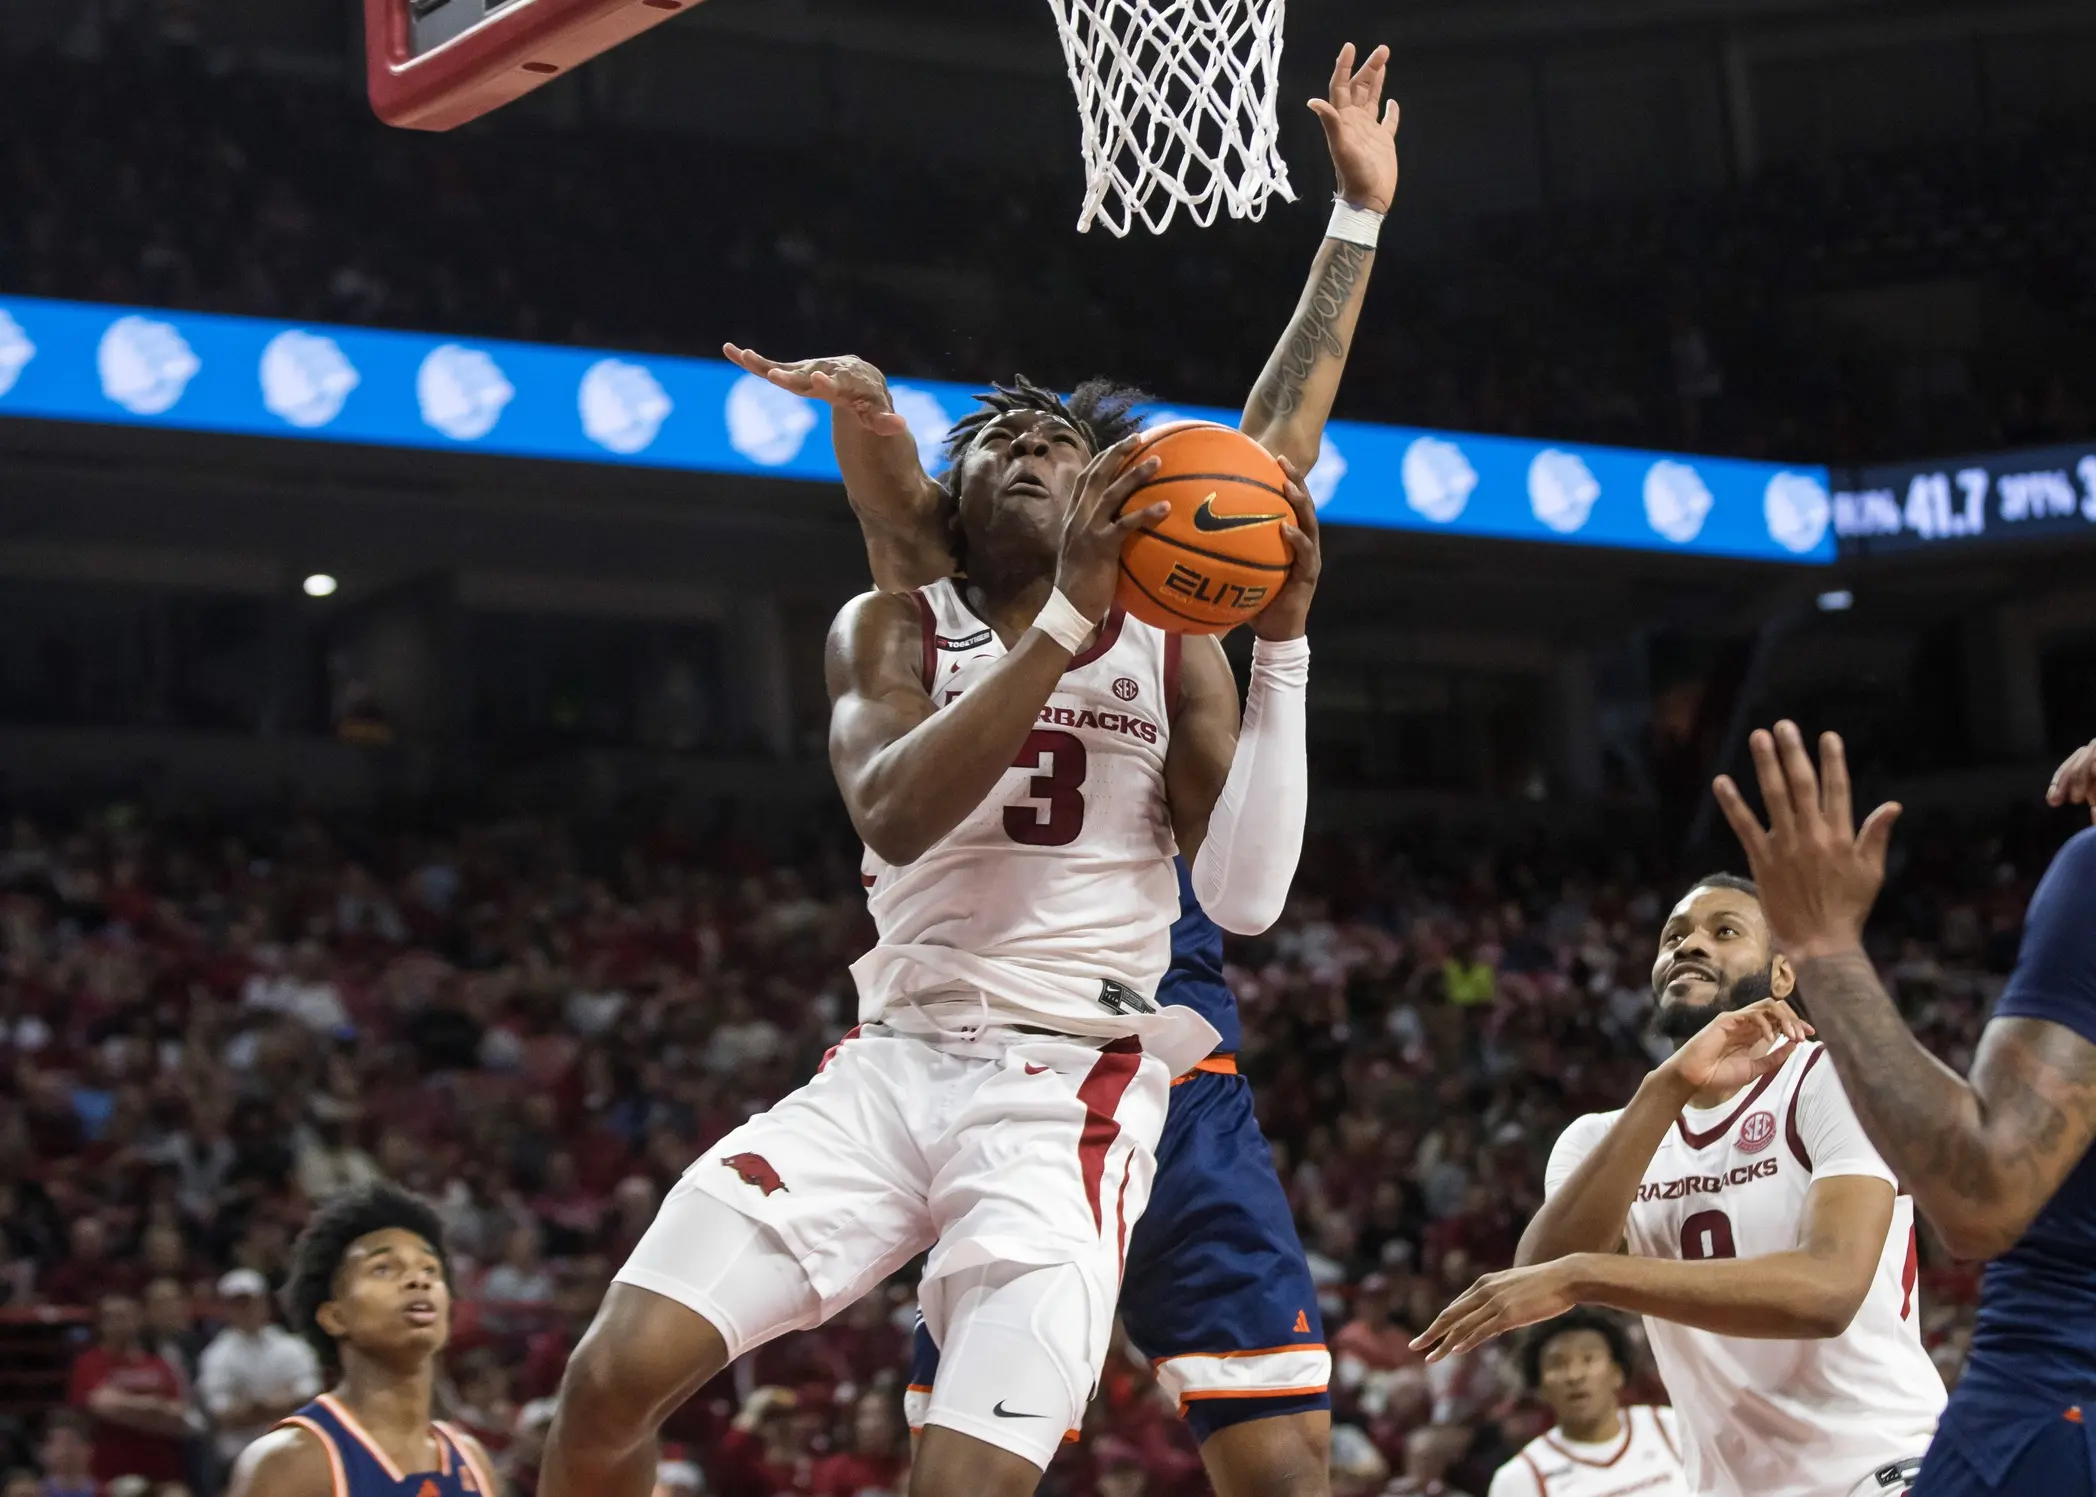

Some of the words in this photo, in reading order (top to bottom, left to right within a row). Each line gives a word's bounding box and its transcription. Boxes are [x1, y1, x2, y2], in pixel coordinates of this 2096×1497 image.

[1904, 468, 1988, 539] 41.7
[1164, 561, 1268, 608] ELITE
[1114, 679, 1137, 700] SEC
[1003, 730, 1087, 846] 3
[1744, 1113, 1772, 1141] SEC
[1634, 1157, 1778, 1203] RAZORBACKS
